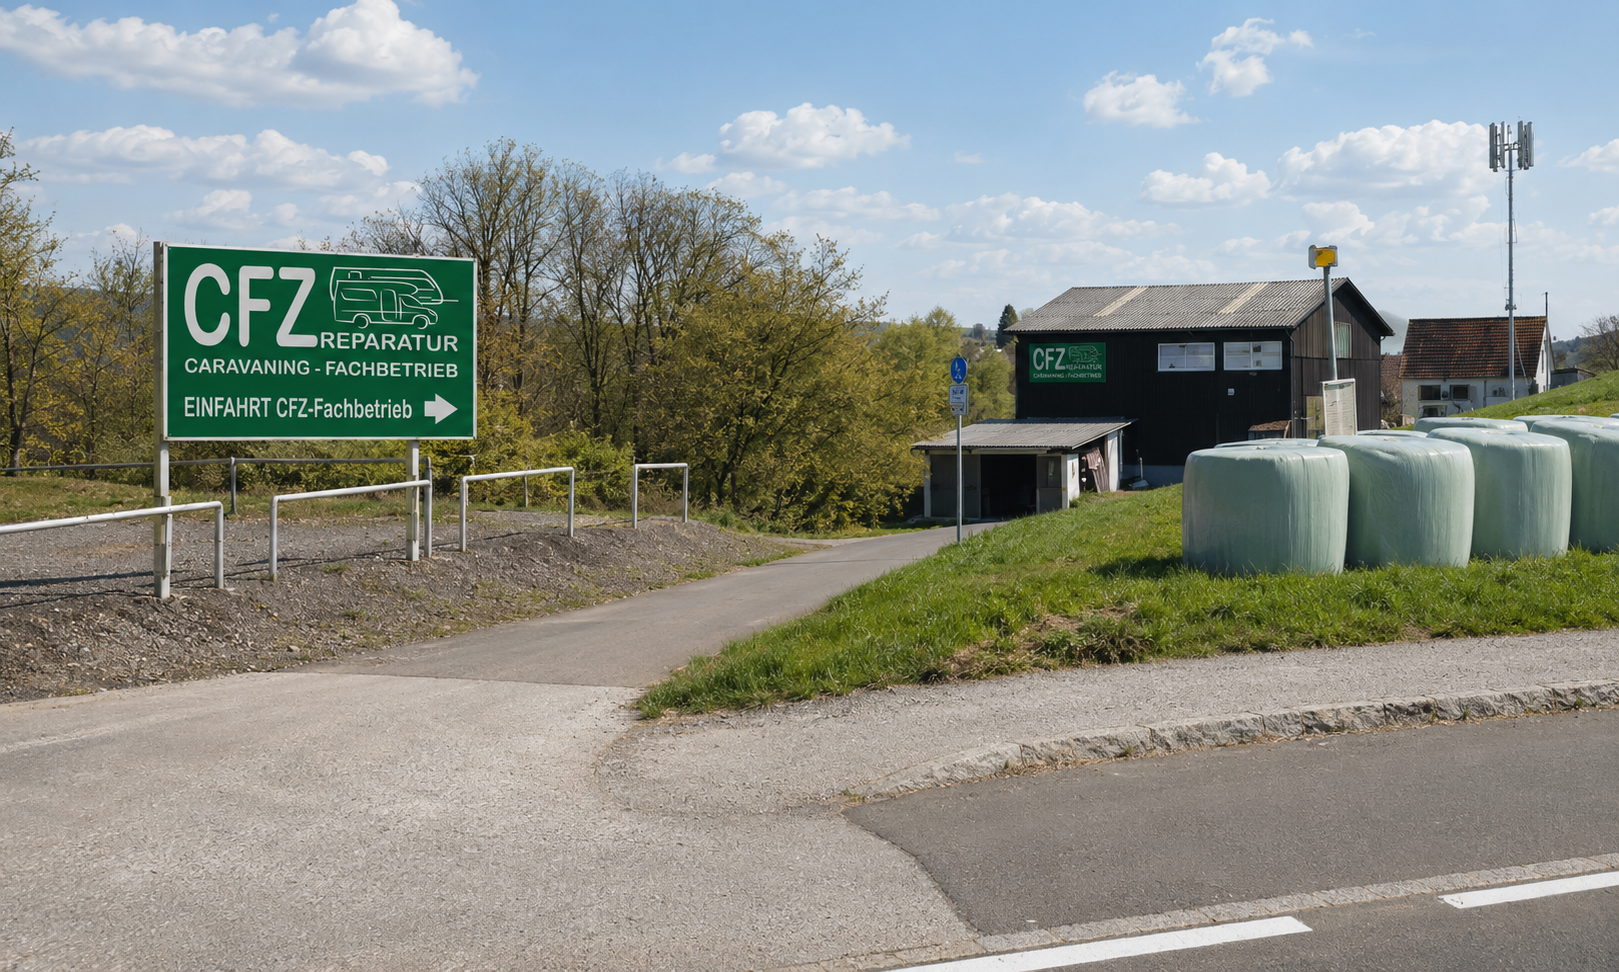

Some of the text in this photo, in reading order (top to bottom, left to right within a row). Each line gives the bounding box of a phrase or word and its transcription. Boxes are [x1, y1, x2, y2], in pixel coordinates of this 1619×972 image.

[185, 262, 458, 352] CFZ REPARATUR
[184, 357, 310, 376] CARAVANING
[325, 361, 458, 378] FACHBETRIEB
[1033, 347, 1066, 371] CFZ
[184, 396, 413, 420] EINFAHRT CFZ-Fachbetrieb
